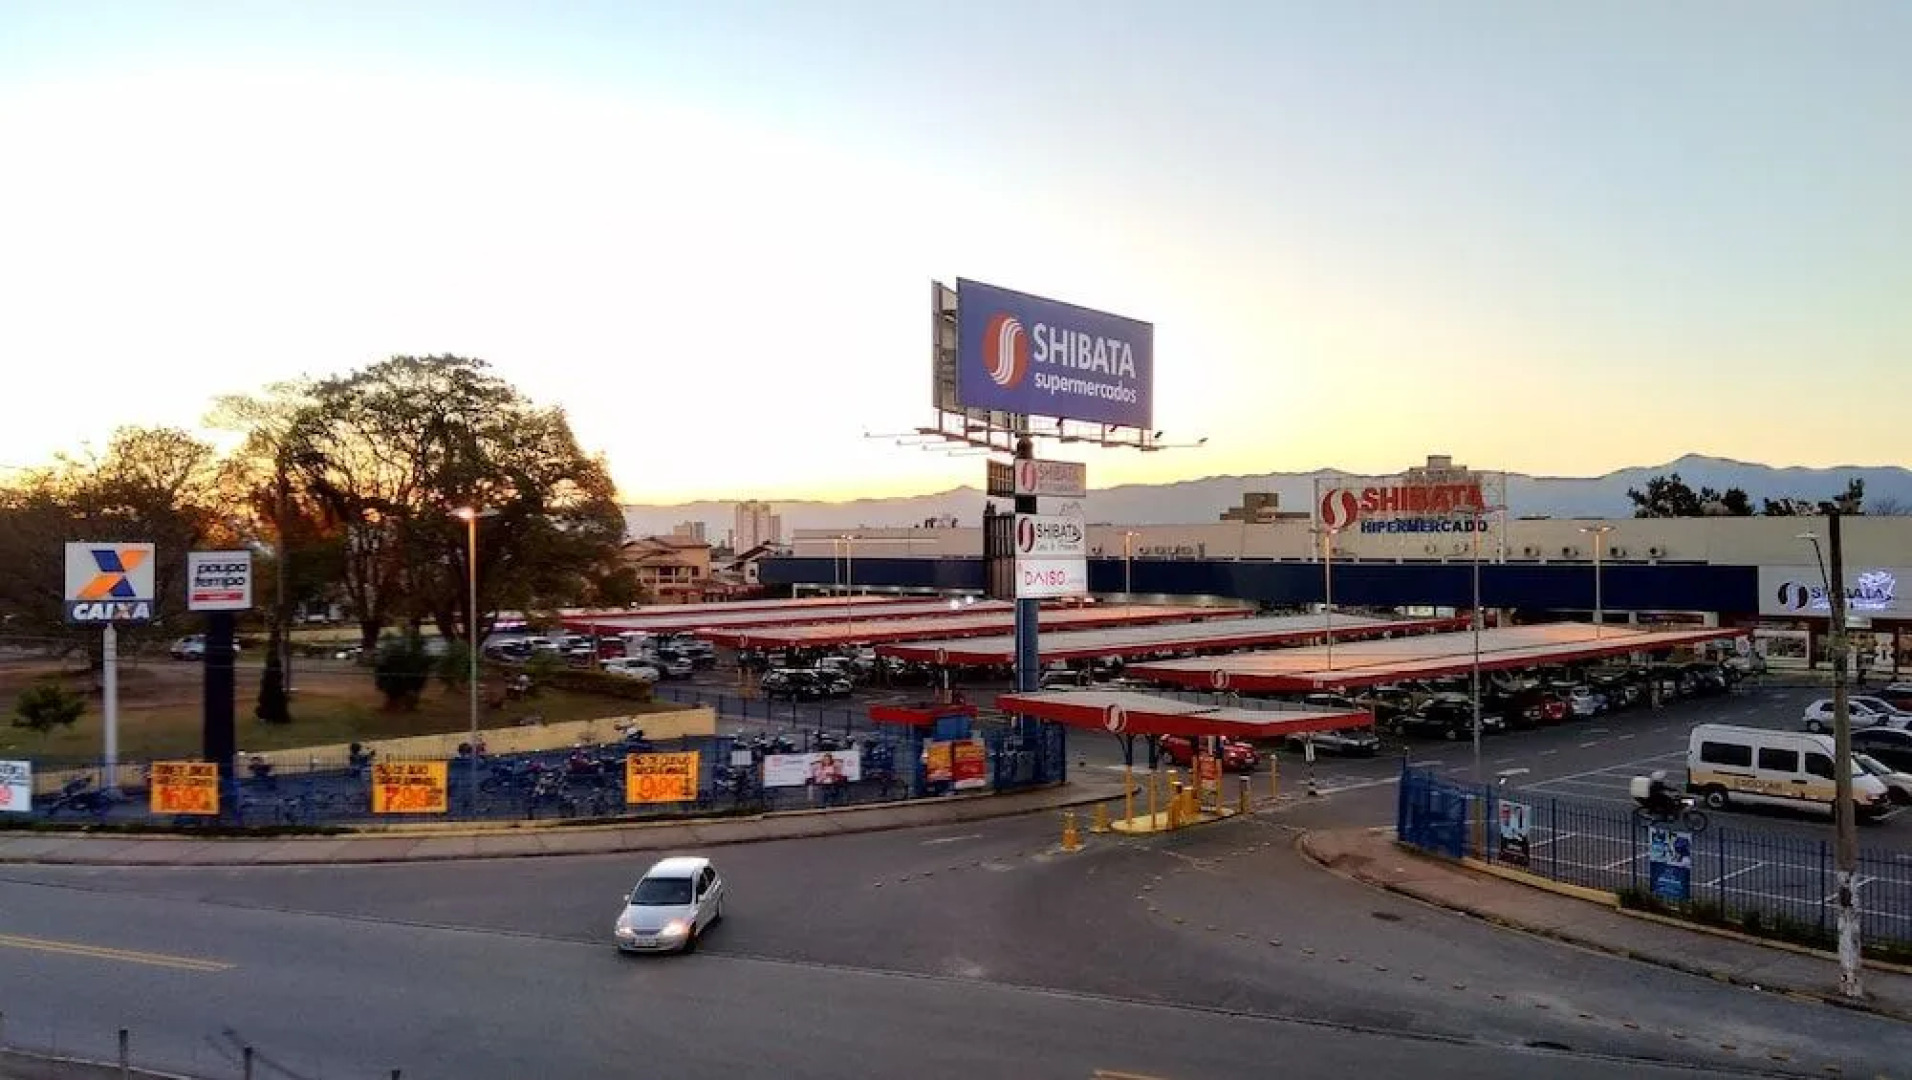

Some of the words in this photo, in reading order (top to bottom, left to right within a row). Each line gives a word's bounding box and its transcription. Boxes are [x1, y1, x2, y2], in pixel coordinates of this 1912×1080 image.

[1033, 322, 1136, 379] SHIBATA
[1034, 371, 1136, 403] supermercados
[1361, 486, 1485, 513] SHIBATA
[1037, 523, 1081, 539] SHIBATA
[1361, 519, 1488, 533] HIPERMERCADO
[1024, 570, 1066, 586] DAISO
[72, 601, 150, 621] CAIXA
